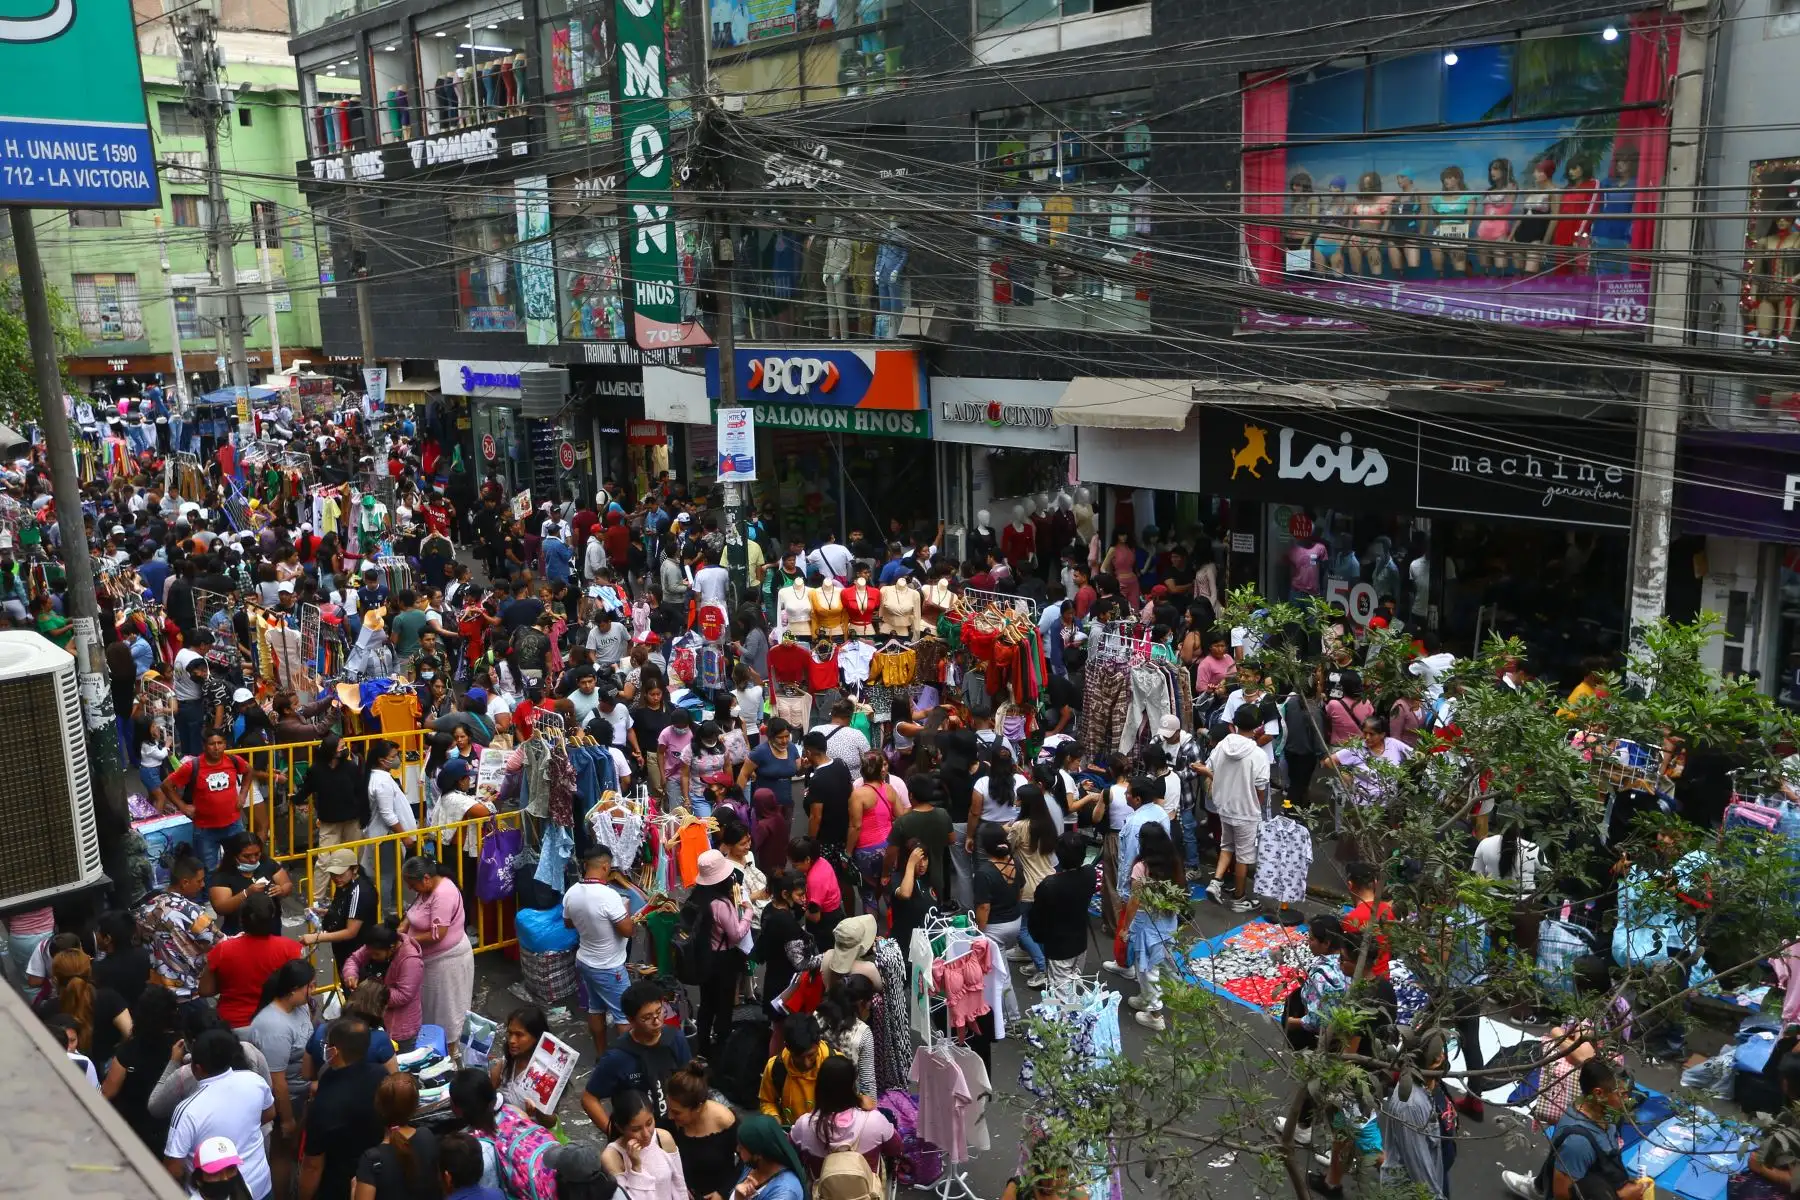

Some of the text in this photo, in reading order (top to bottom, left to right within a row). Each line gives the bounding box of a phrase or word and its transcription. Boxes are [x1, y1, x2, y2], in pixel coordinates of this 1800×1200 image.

[5, 139, 137, 163] H. UNANUE 1590
[4, 166, 35, 186] 712
[47, 168, 71, 187] LA
[73, 168, 150, 189] VICTORIA
[636, 280, 675, 306] HNOS
[1613, 297, 1636, 305] TDA
[1602, 305, 1646, 322] 203
[646, 329, 682, 343] 705
[583, 343, 617, 364] TRAINING
[762, 357, 823, 395] BCP
[754, 405, 921, 434] SALOMON HNOS.
[941, 401, 985, 423] LADY
[1277, 427, 1389, 486] Lois
[1450, 453, 1624, 484] machine
[1542, 480, 1625, 507] generation
[1326, 580, 1378, 625] 50
[600, 636, 618, 646] BOSS
